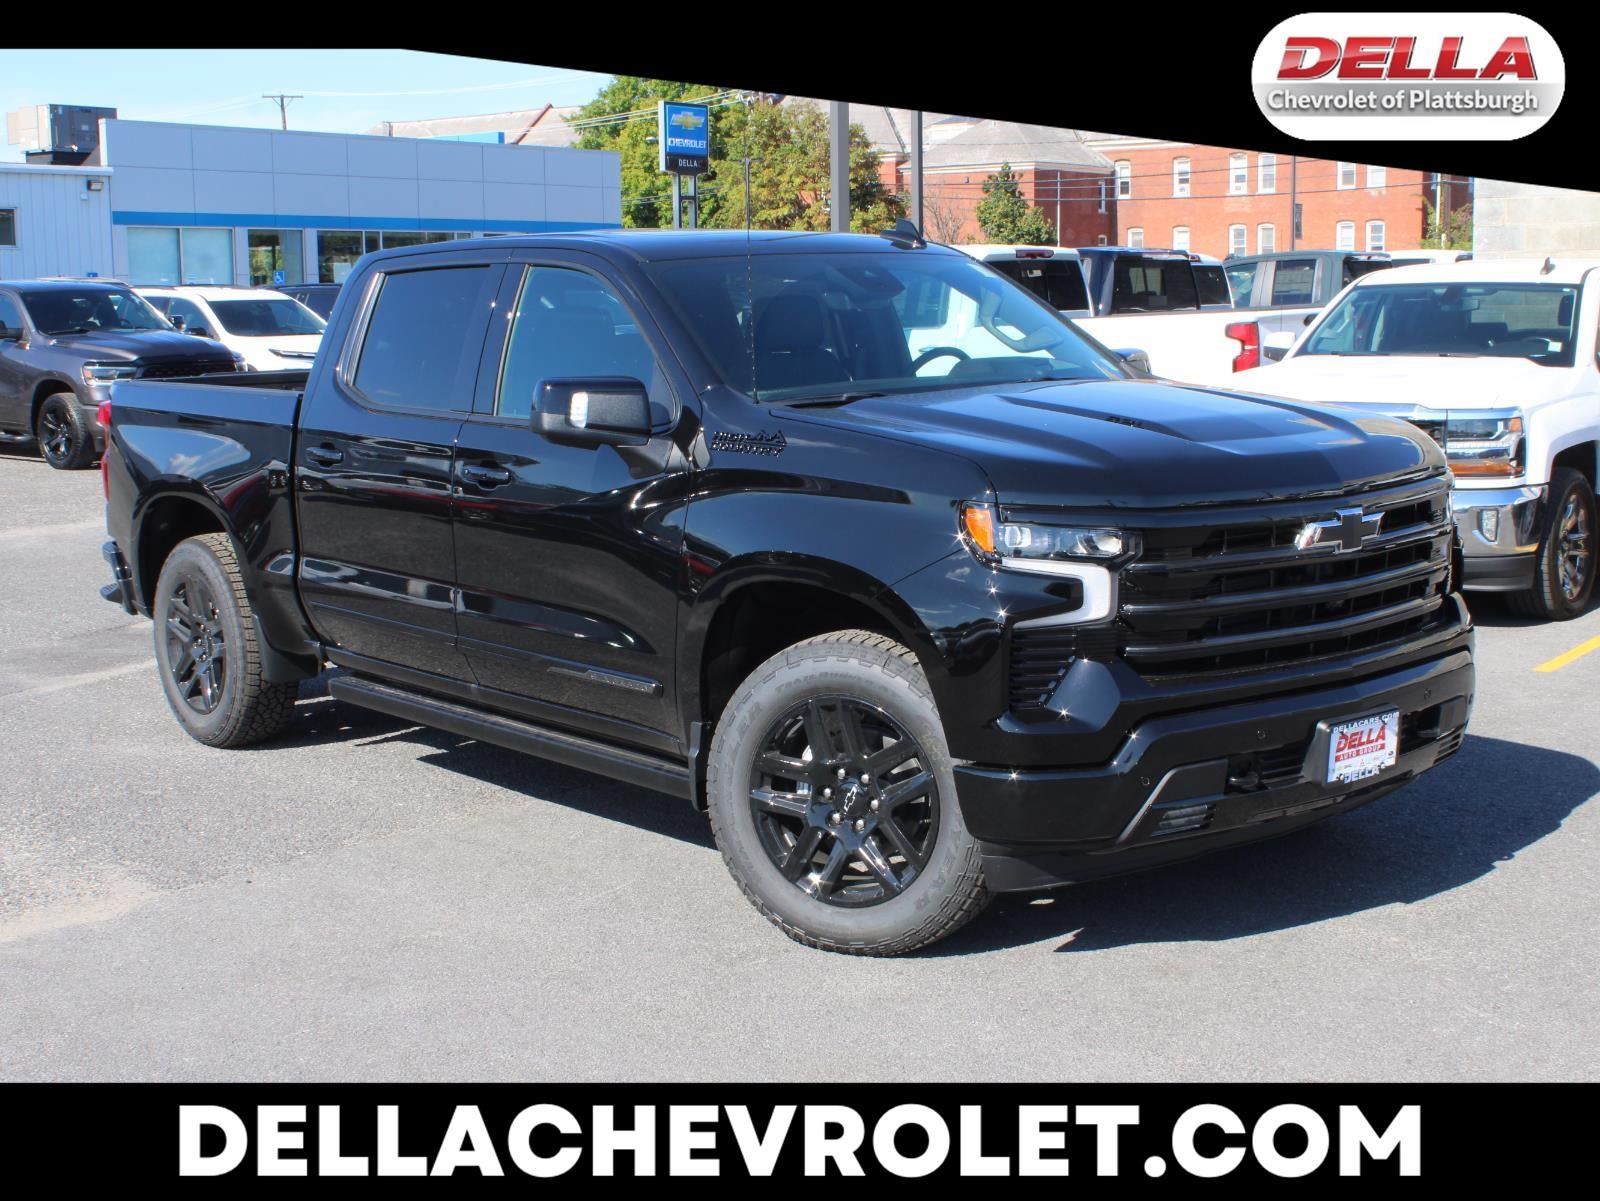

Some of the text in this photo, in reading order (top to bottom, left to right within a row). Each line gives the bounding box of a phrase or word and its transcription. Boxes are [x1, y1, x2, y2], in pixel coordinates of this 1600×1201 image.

[668, 137, 707, 149] CHEVROLET
[679, 159, 697, 167] DELLA
[1336, 724, 1386, 753] DELLA
[1340, 744, 1380, 761] AUTO GROUP
